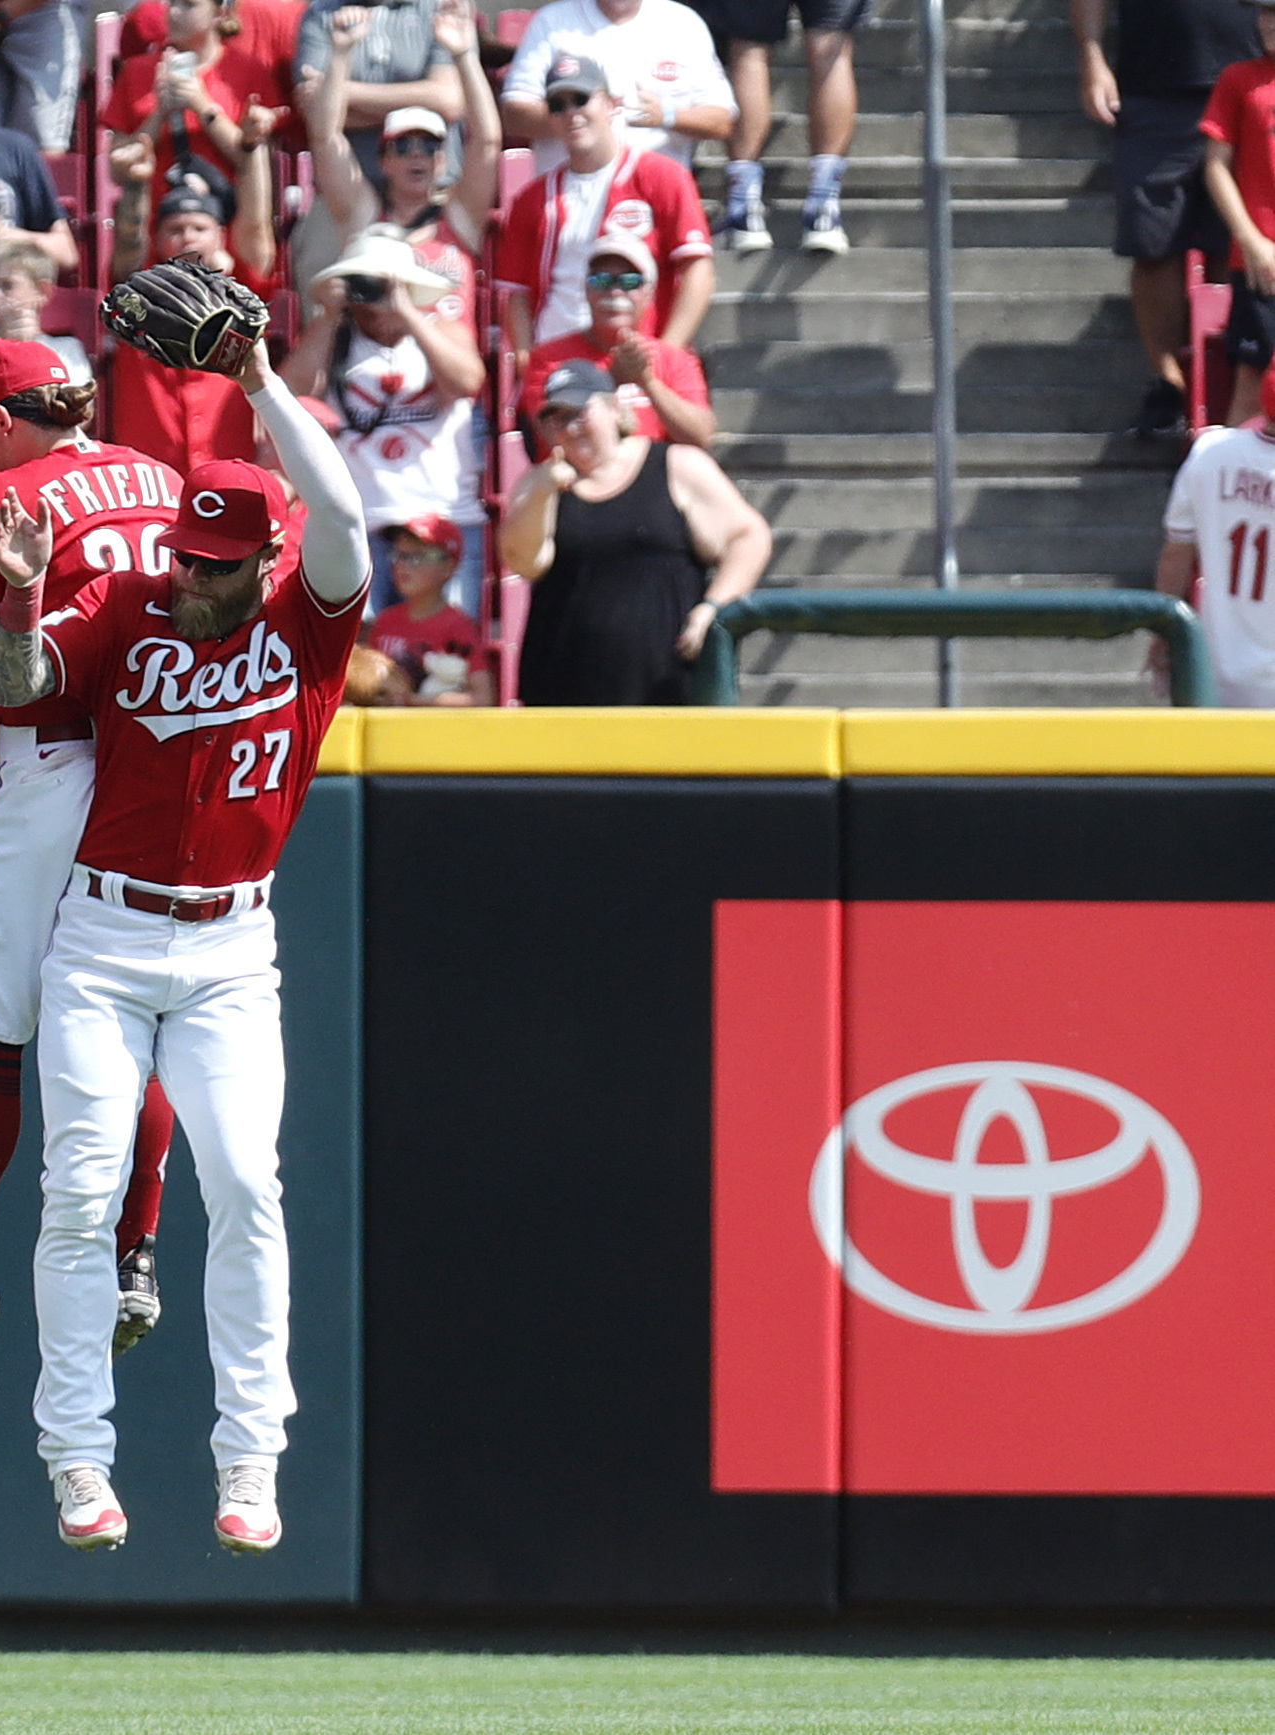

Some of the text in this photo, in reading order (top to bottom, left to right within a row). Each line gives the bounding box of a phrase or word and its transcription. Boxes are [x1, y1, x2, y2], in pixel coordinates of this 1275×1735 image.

[1229, 520, 1269, 602] 11
[115, 620, 298, 713] Reds
[227, 729, 292, 799] 27
